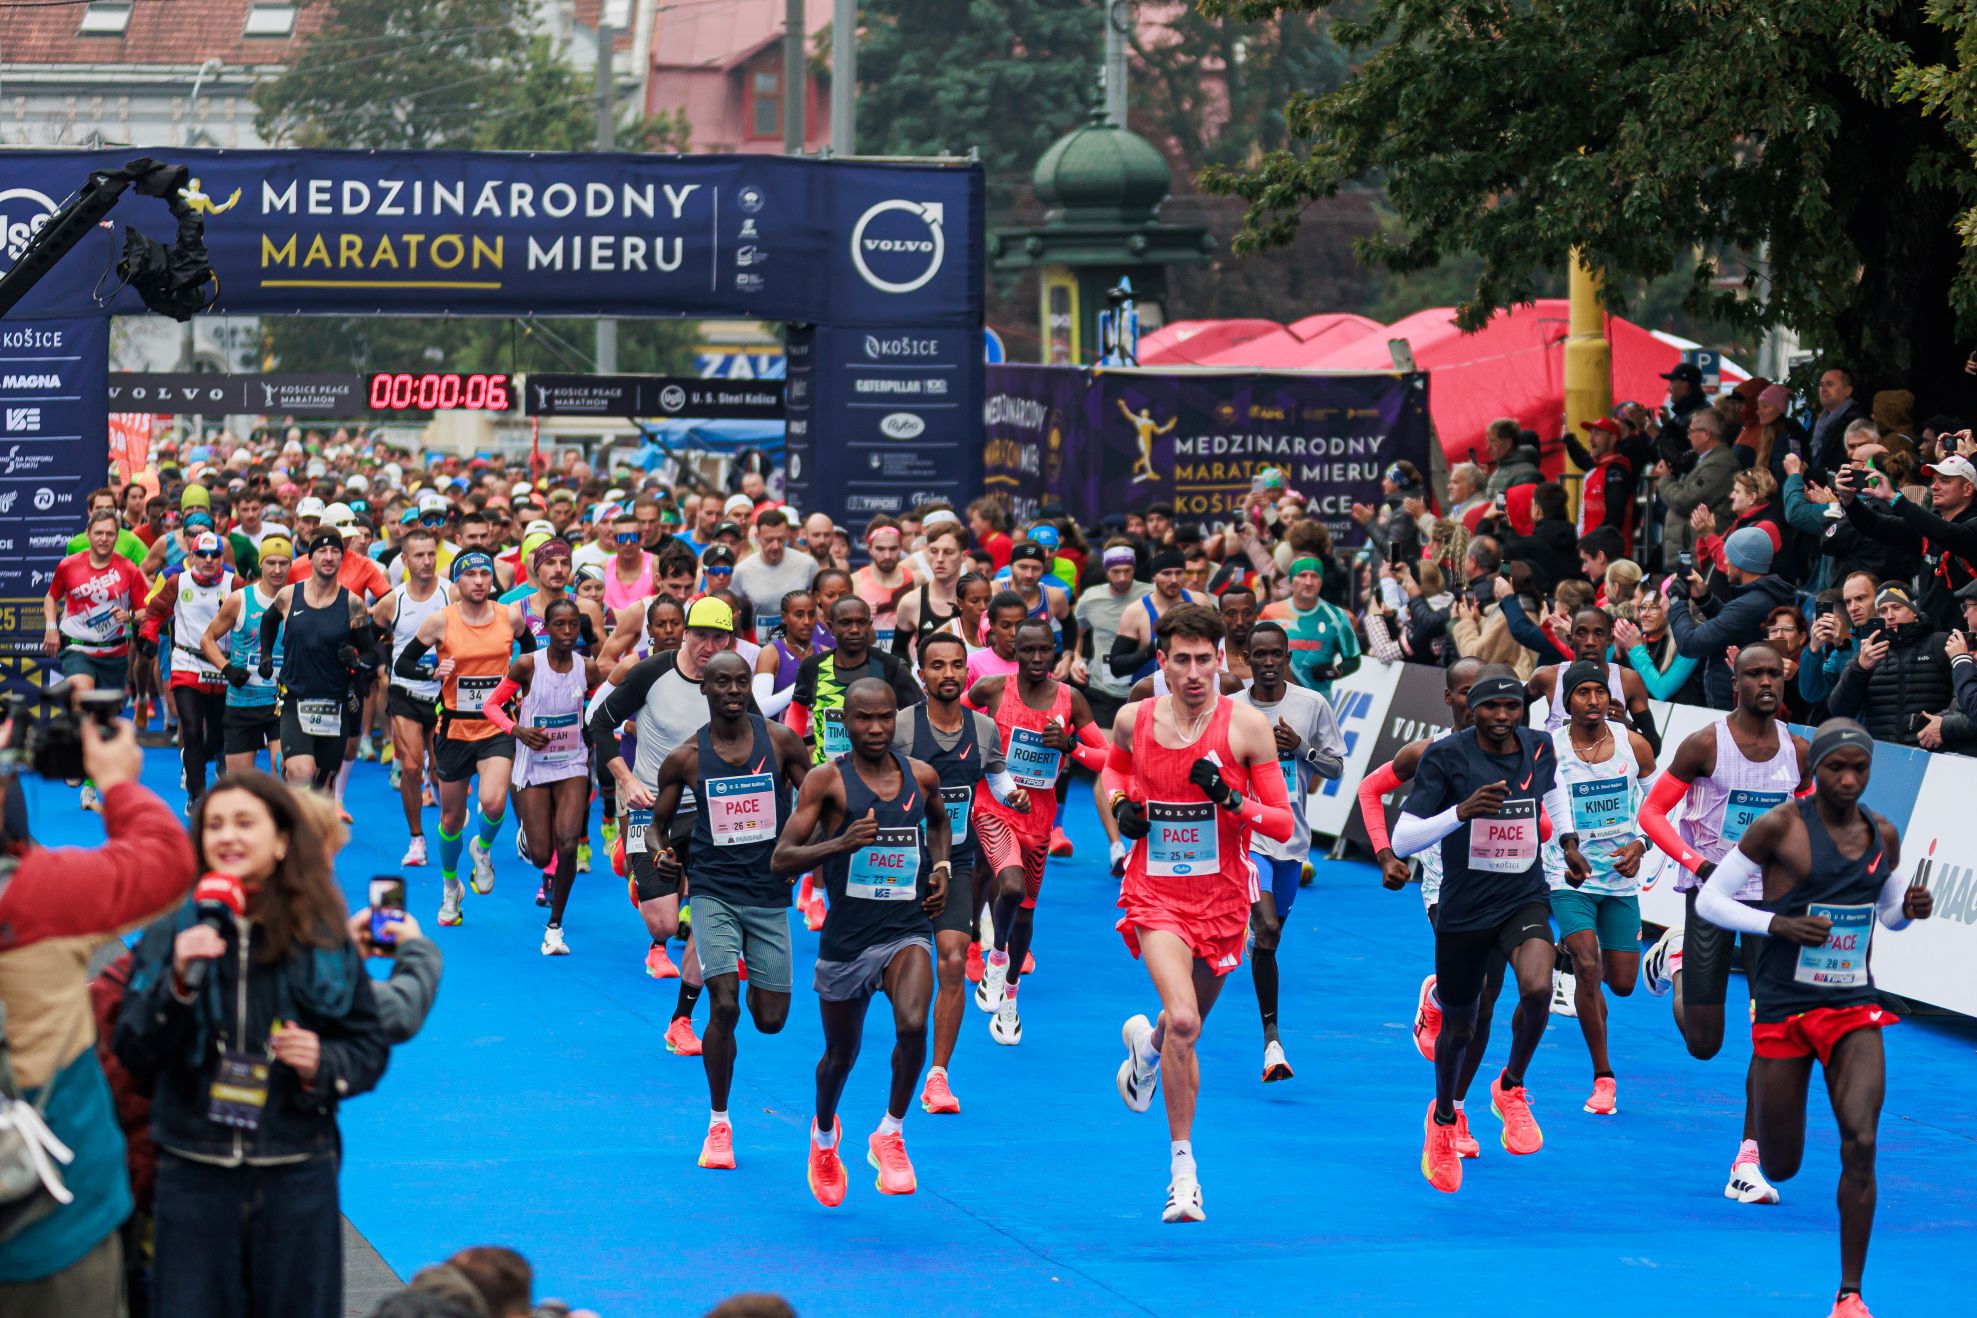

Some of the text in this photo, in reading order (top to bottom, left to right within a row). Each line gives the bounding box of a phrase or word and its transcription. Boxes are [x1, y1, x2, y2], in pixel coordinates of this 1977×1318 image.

[864, 239, 933, 252] VOLVO
[528, 234, 684, 272] MIERU
[3, 328, 63, 348] KOŠICE
[881, 337, 939, 355] KOŠICE
[2, 375, 61, 389] MAGNA
[856, 379, 921, 393] CATERPILLAR
[108, 387, 225, 400] VOLVO
[1303, 462, 1379, 481] MIERU
[469, 690, 482, 701] 34
[1014, 747, 1056, 764] ROBERT
[725, 799, 760, 815] PACE
[1154, 808, 1208, 816] VOLVO
[1498, 806, 1530, 815] LVO
[1585, 798, 1621, 814] KINDE
[733, 821, 744, 831] 26
[1488, 825, 1524, 841] PACE
[1162, 827, 1200, 844] PACE
[1170, 851, 1181, 861] 25
[1495, 848, 1506, 857] 27
[868, 852, 905, 868] PACE
[873, 875, 884, 885] 23
[1822, 933, 1858, 951] PACE
[1826, 958, 1838, 969] 28
